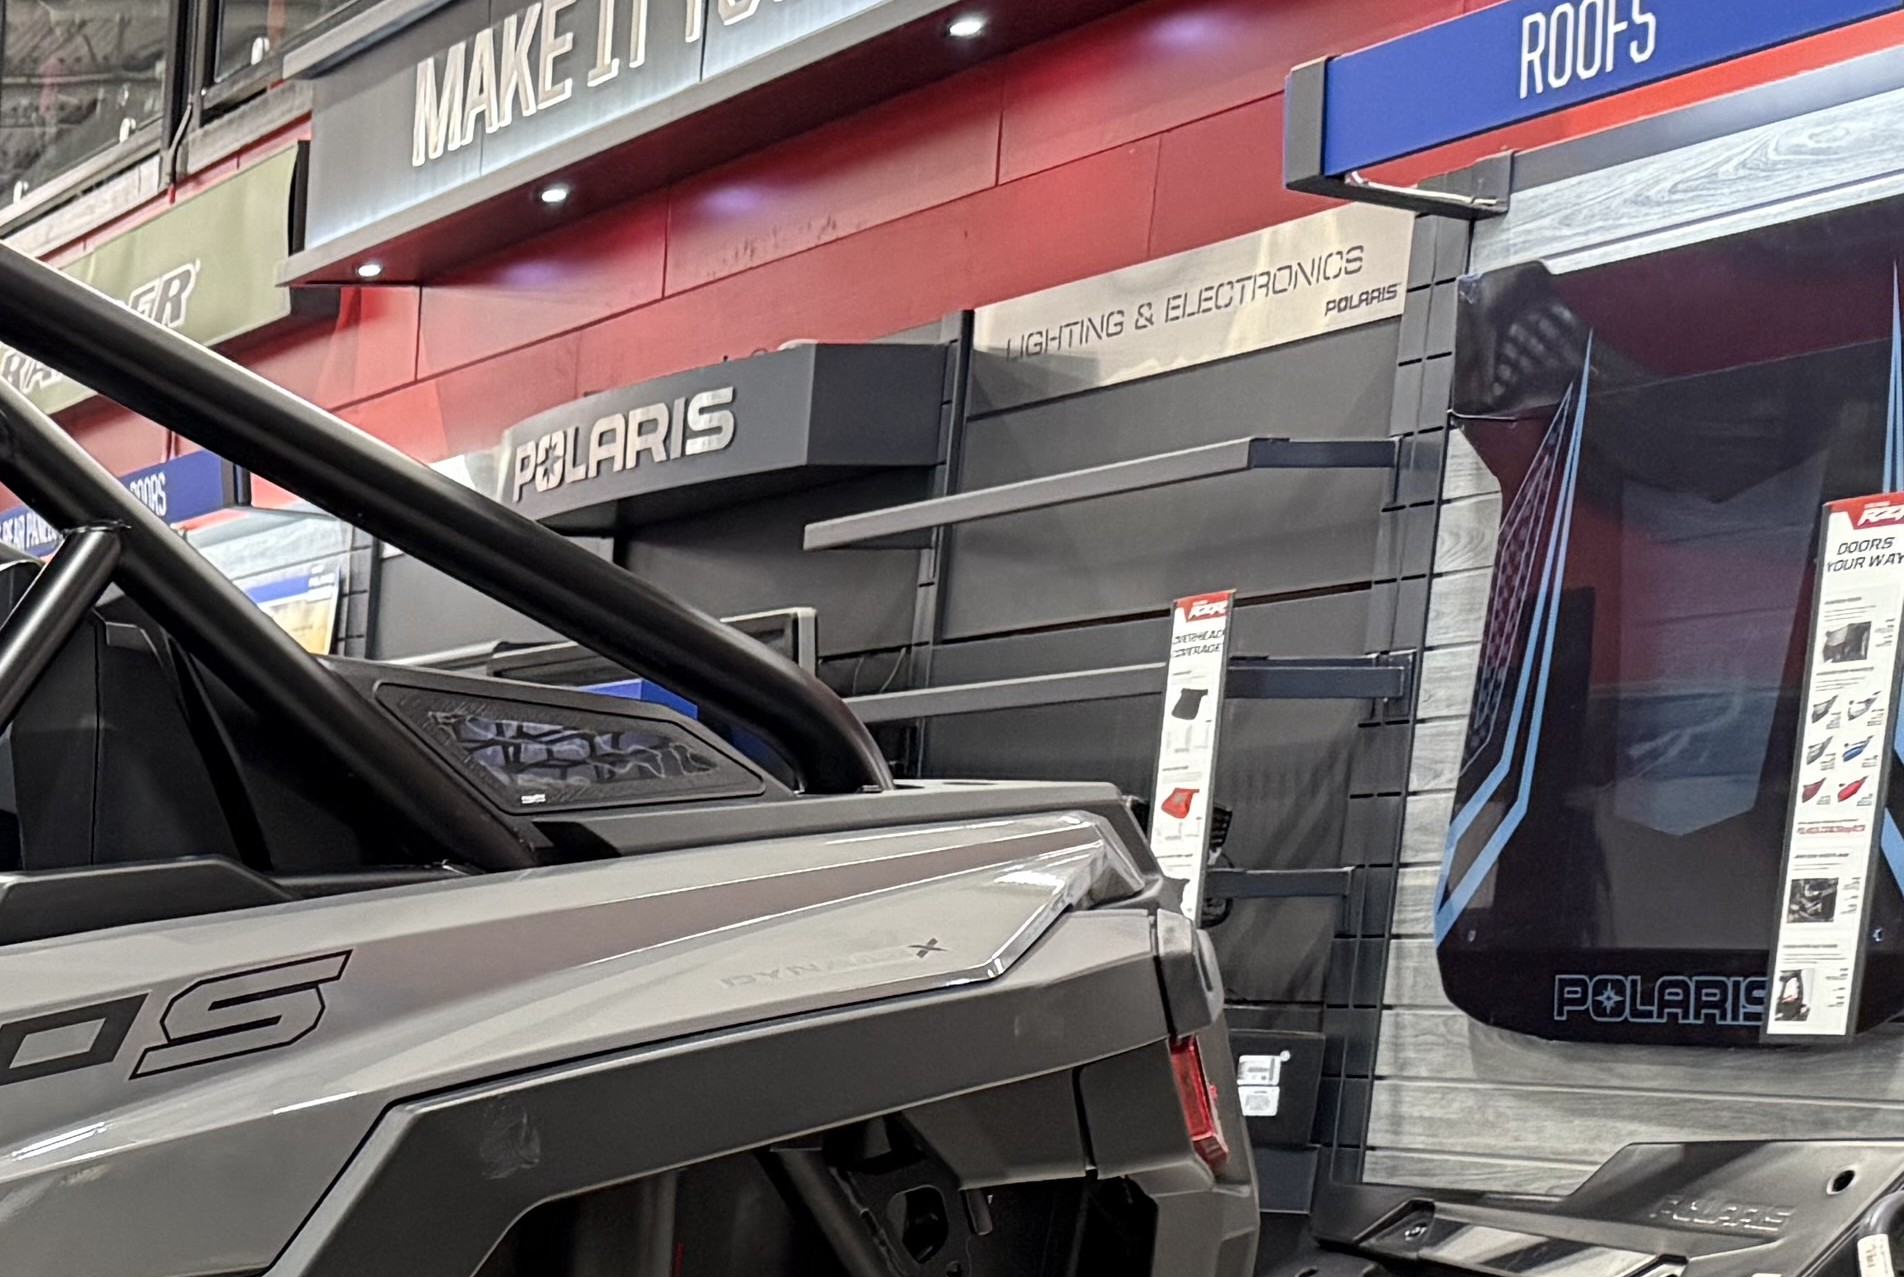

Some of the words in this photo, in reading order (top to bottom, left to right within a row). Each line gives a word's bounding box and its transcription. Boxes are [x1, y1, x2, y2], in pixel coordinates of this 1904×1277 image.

[411, 0, 576, 167] MAKE
[1519, 0, 1657, 100] ROOFS
[1005, 309, 1125, 363] LIGHTING
[1133, 300, 1155, 331] &
[1163, 244, 1365, 325] ELECTRONICS
[1324, 283, 1400, 317] POLARIS
[512, 385, 735, 503] POLARIS
[1826, 555, 1866, 574] YOUR
[1868, 552, 1904, 568] WAY
[1836, 536, 1896, 557] DOORS
[128, 948, 354, 1081] S
[1553, 974, 1769, 1027] POLARIS
